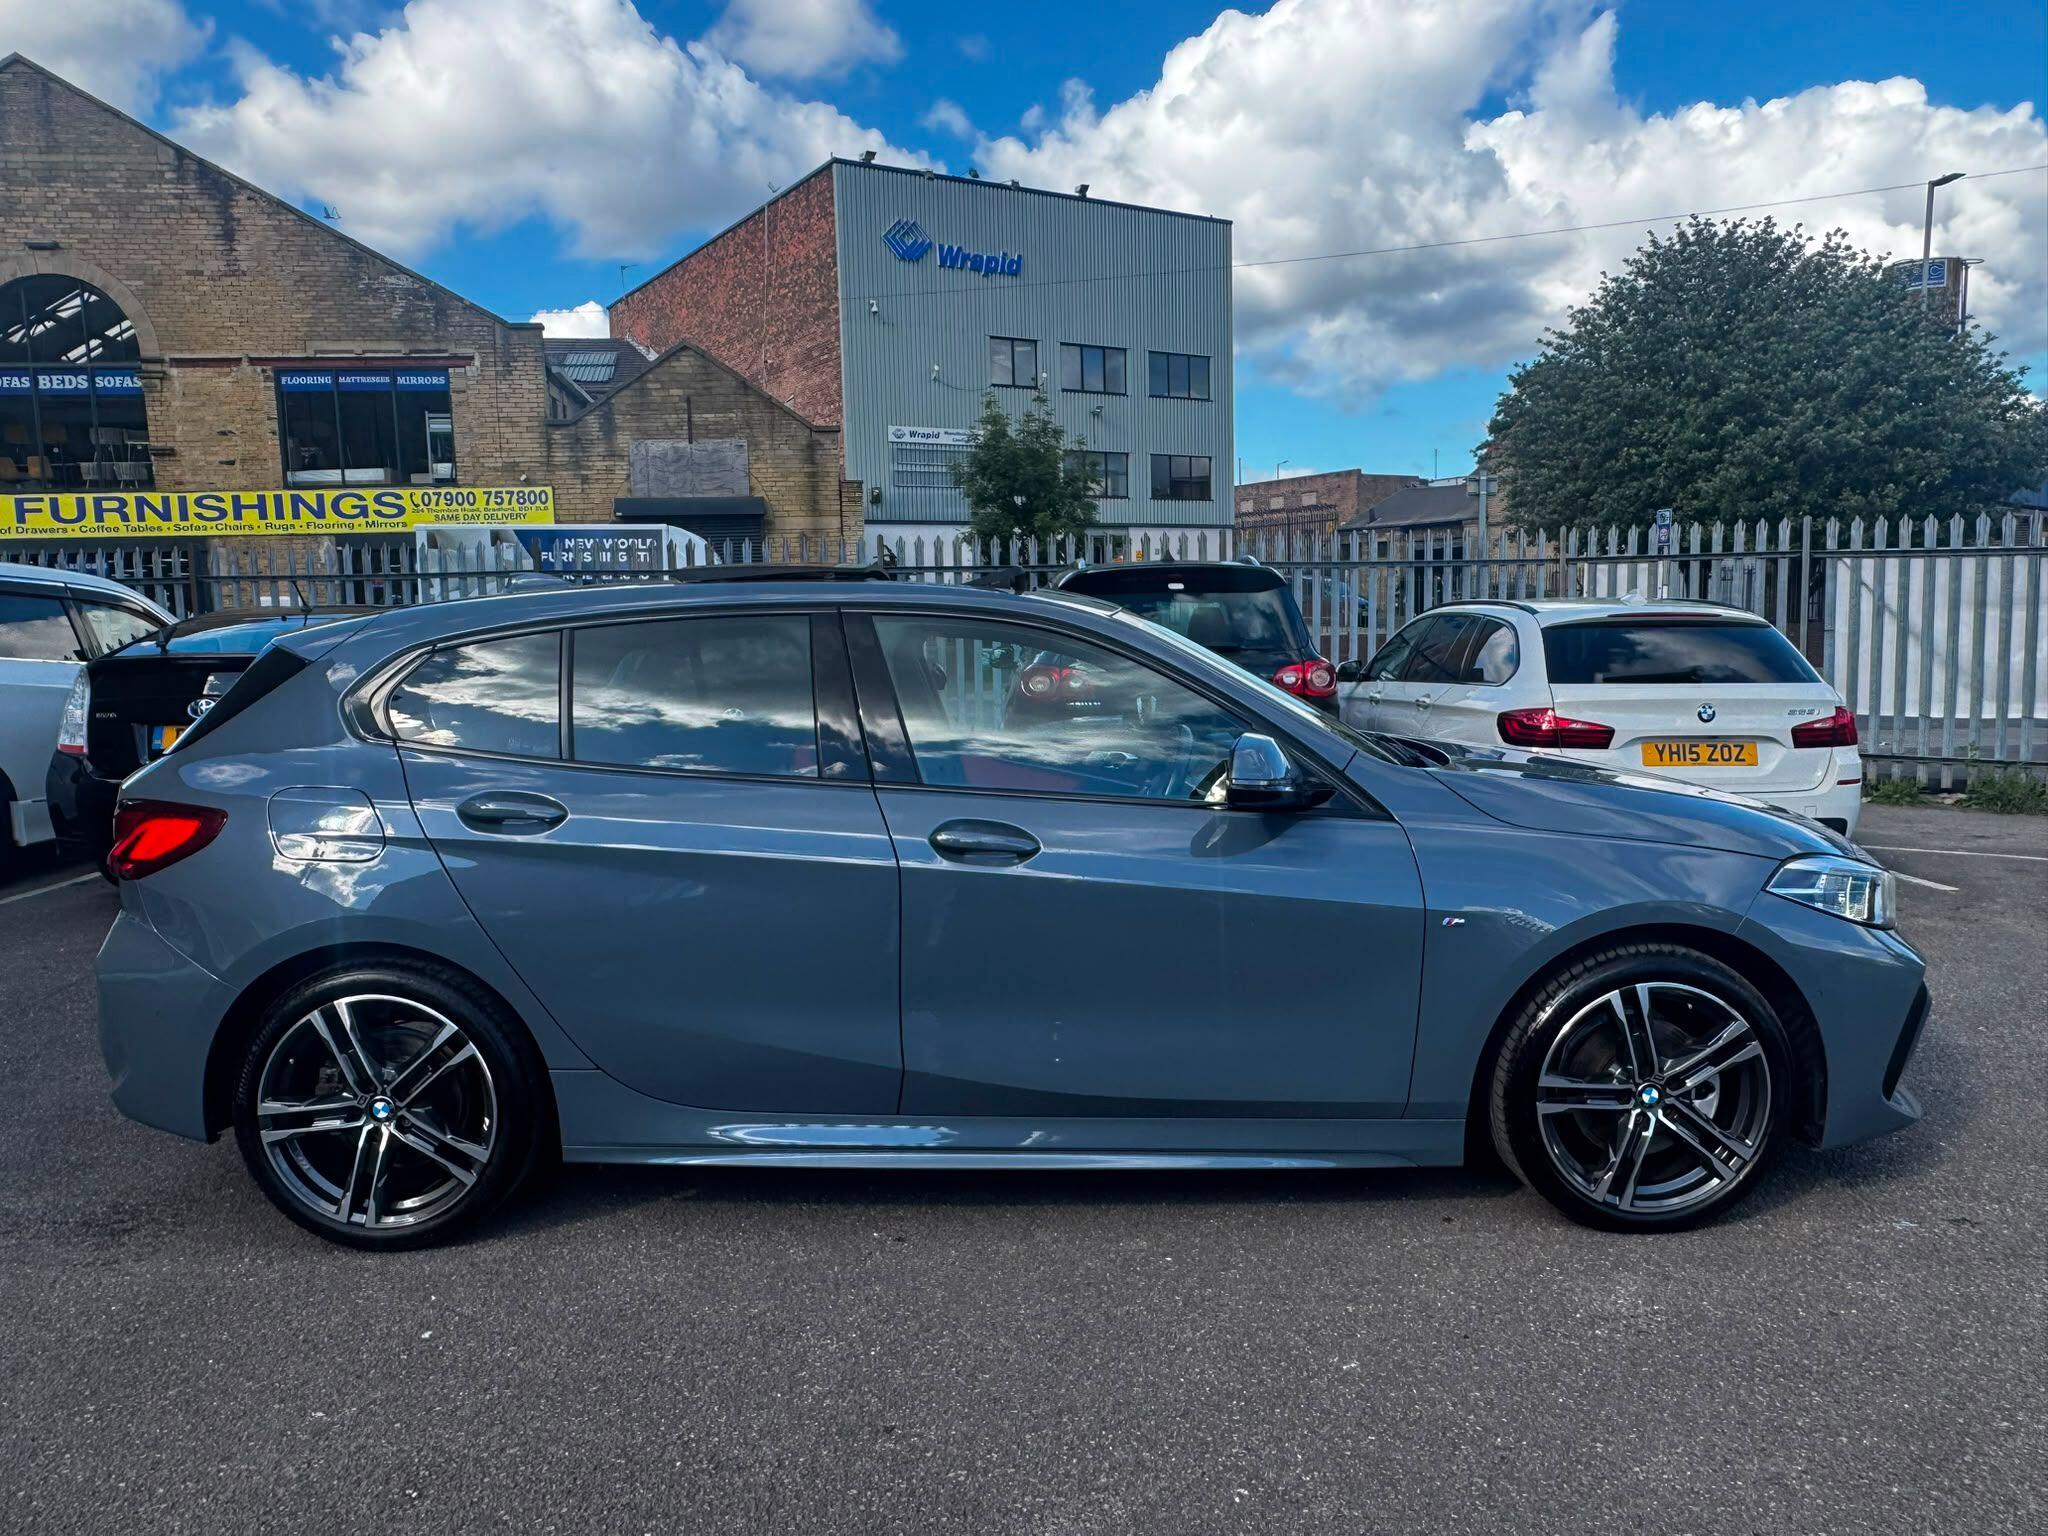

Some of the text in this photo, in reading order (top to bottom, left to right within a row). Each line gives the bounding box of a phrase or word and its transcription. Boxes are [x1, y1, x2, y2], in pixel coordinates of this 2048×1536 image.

[937, 243, 1022, 277] Wrapid
[0, 375, 142, 389] FAS BEDS SOFAS
[281, 376, 332, 385] FLOORING
[397, 376, 446, 385] MIRRORS
[909, 430, 940, 440] Wrapid
[421, 490, 549, 507] 07900 757800
[14, 491, 407, 525] FURNISHINGS
[434, 512, 528, 522] SAME DAY DELIVERY
[16, 526, 68, 534] Drawers
[79, 525, 120, 533] Coffee
[123, 524, 163, 533] Tables
[173, 523, 208, 532] Sofas
[215, 522, 255, 532] Chairs
[265, 522, 296, 532] Rugs
[306, 521, 355, 531] Flooring
[365, 520, 408, 529] Mirrors
[1655, 743, 1747, 763] YH15 ZOZ
